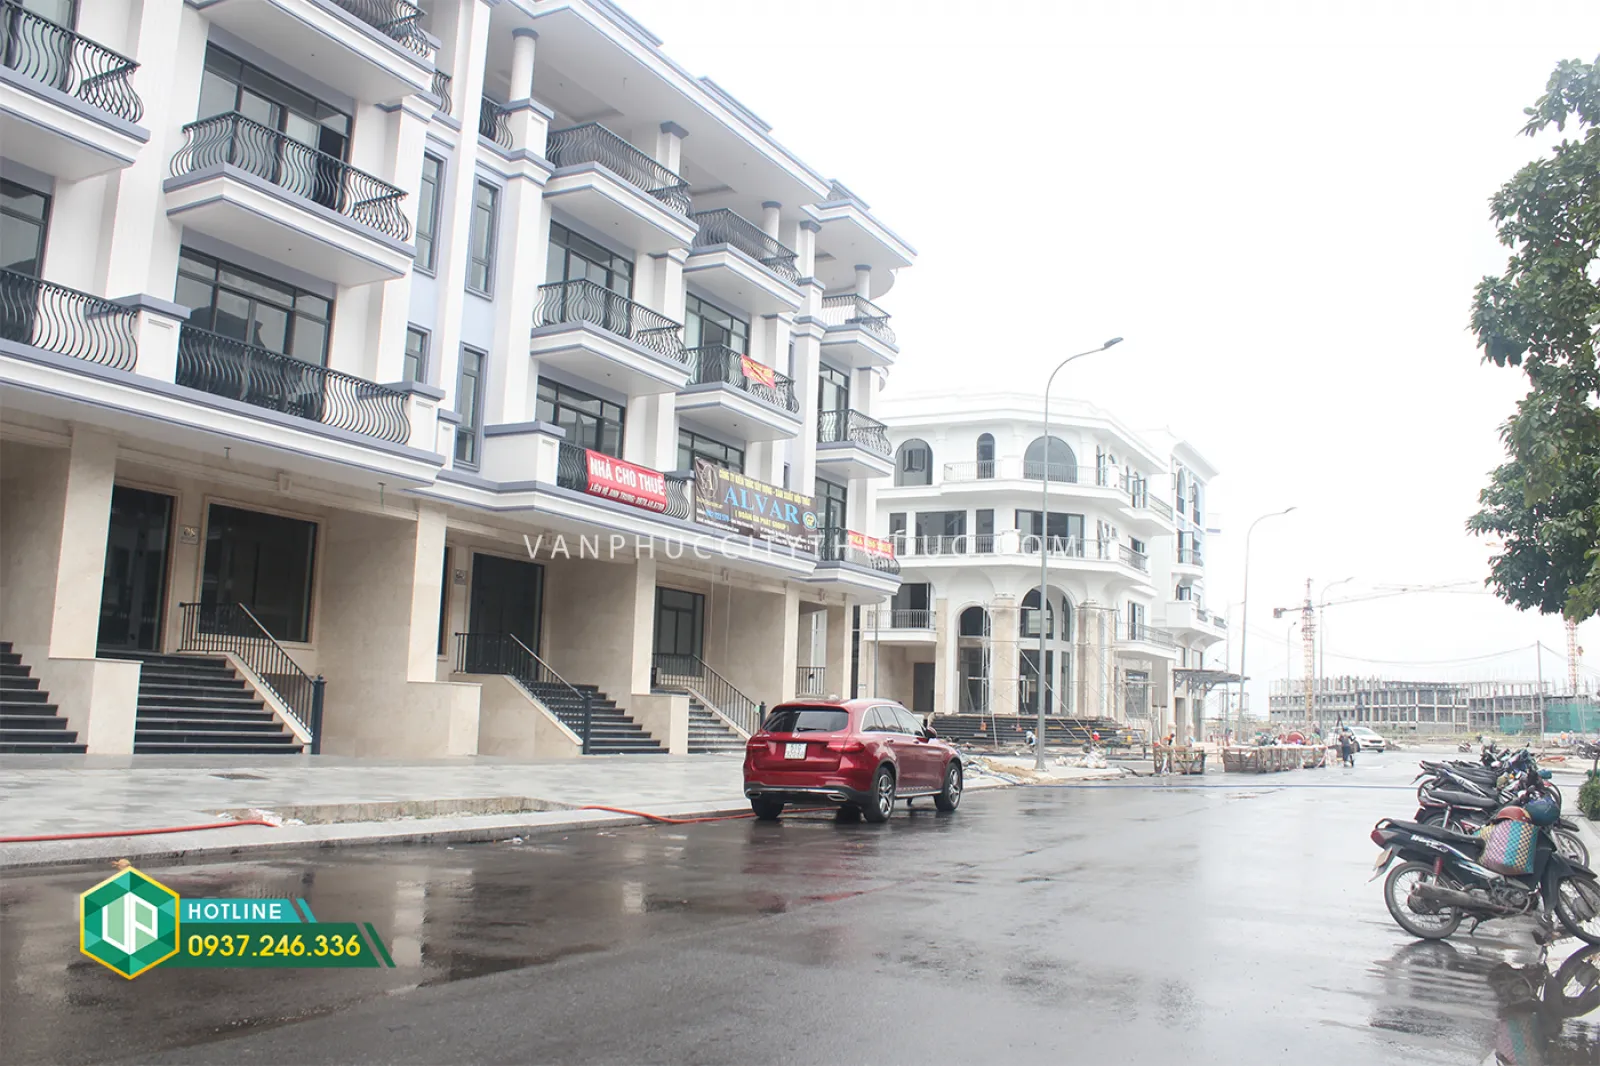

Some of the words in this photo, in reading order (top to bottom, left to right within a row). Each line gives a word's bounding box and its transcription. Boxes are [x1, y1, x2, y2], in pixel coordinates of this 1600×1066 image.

[590, 457, 613, 481] NHÀ
[615, 466, 637, 488] CHO
[638, 473, 665, 497] THUÊ
[724, 485, 800, 525] ALVAR
